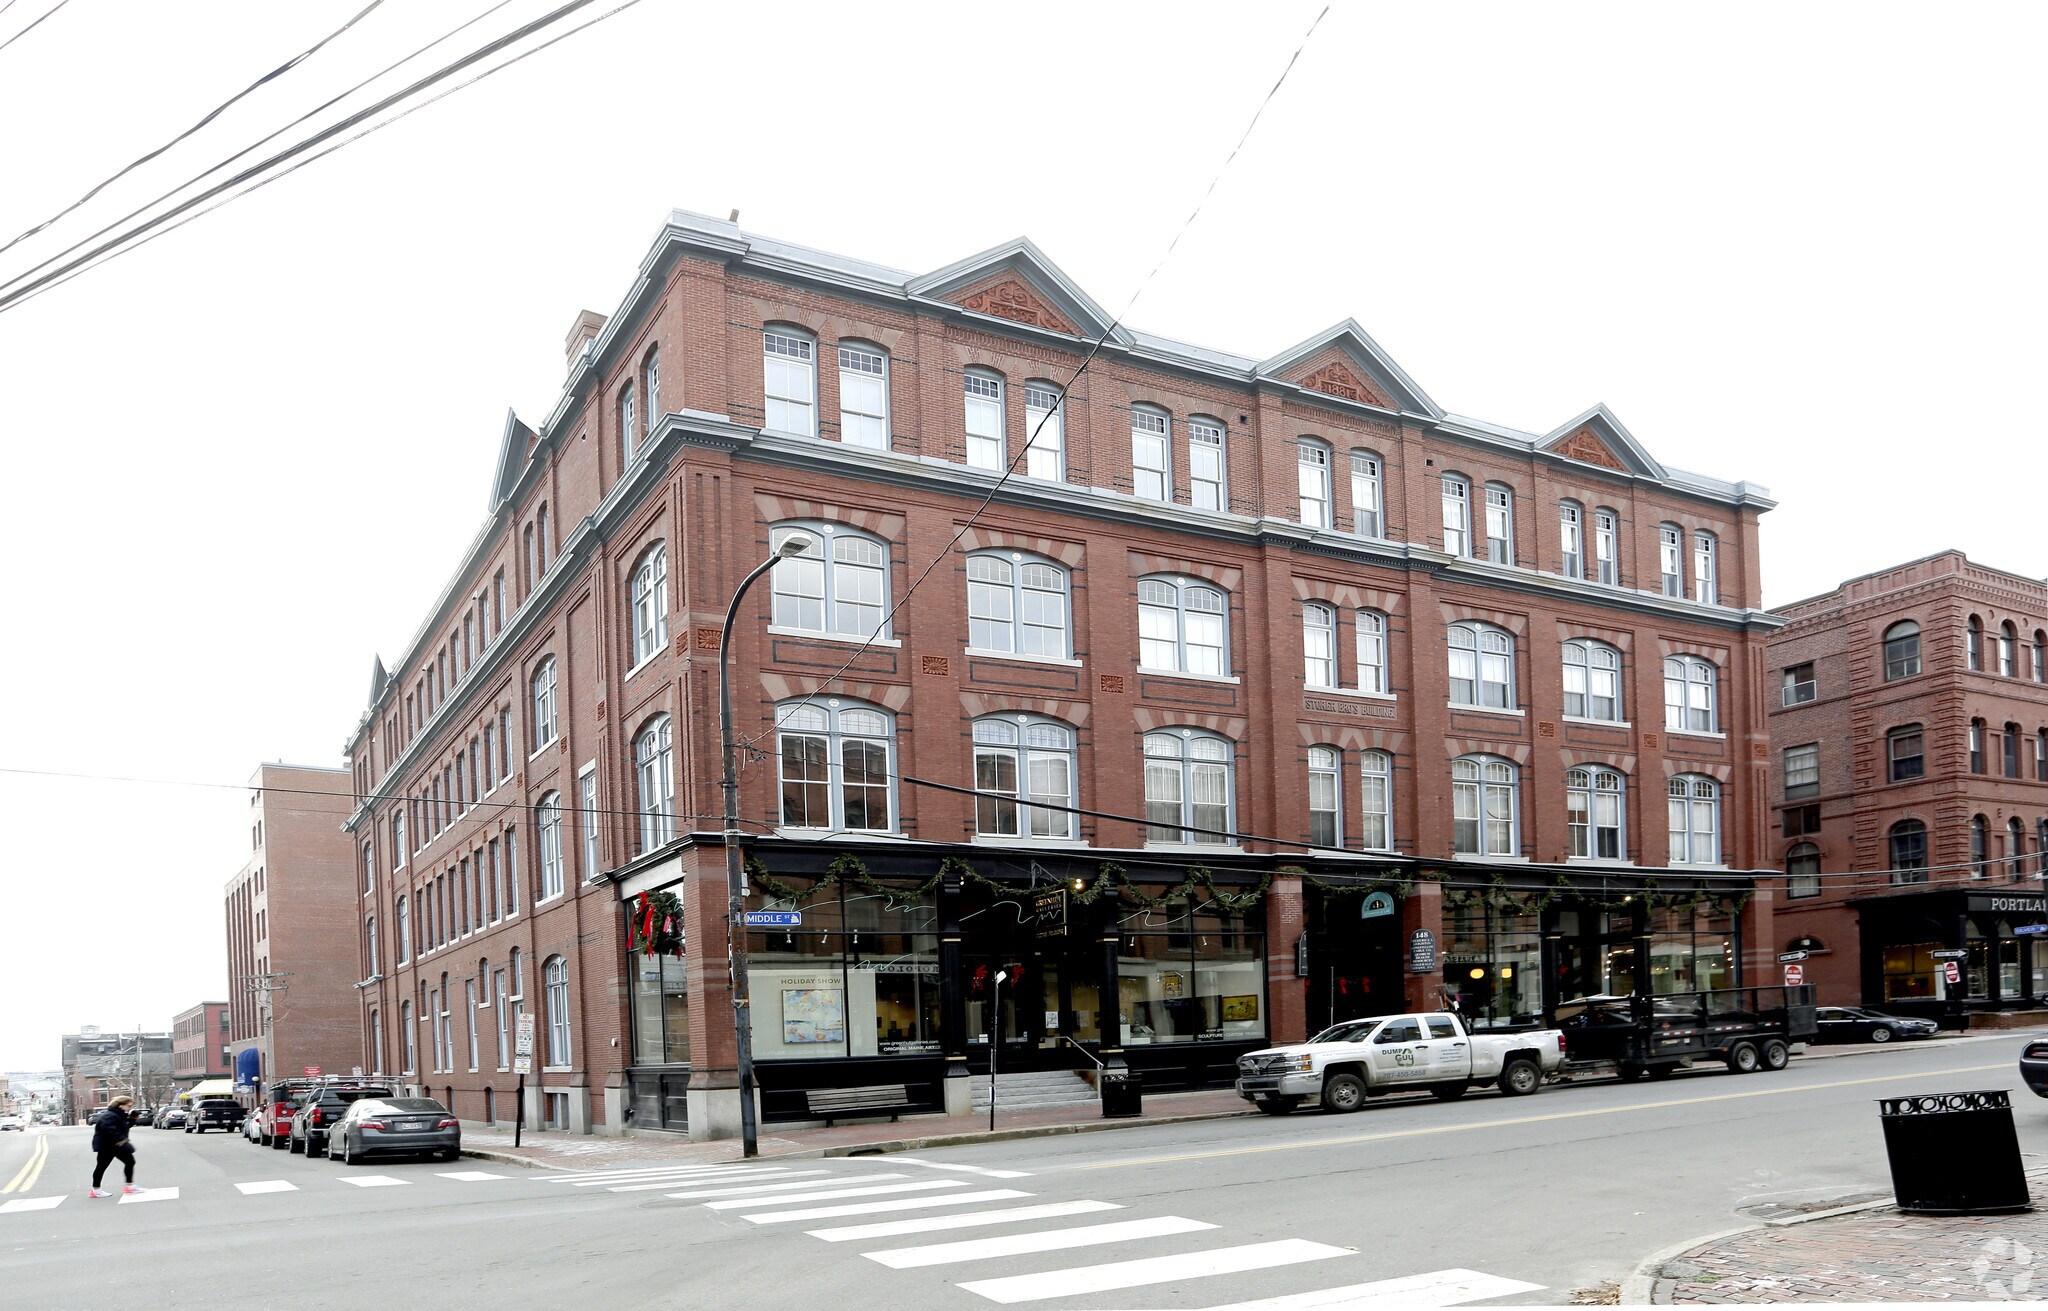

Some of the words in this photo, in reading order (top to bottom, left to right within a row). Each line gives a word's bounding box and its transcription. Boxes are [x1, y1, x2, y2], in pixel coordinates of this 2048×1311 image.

[1328, 384, 1350, 398] 1881
[1305, 700, 1336, 713] STORER
[747, 914, 783, 923] MIDDLE
[1416, 931, 1429, 939] 148
